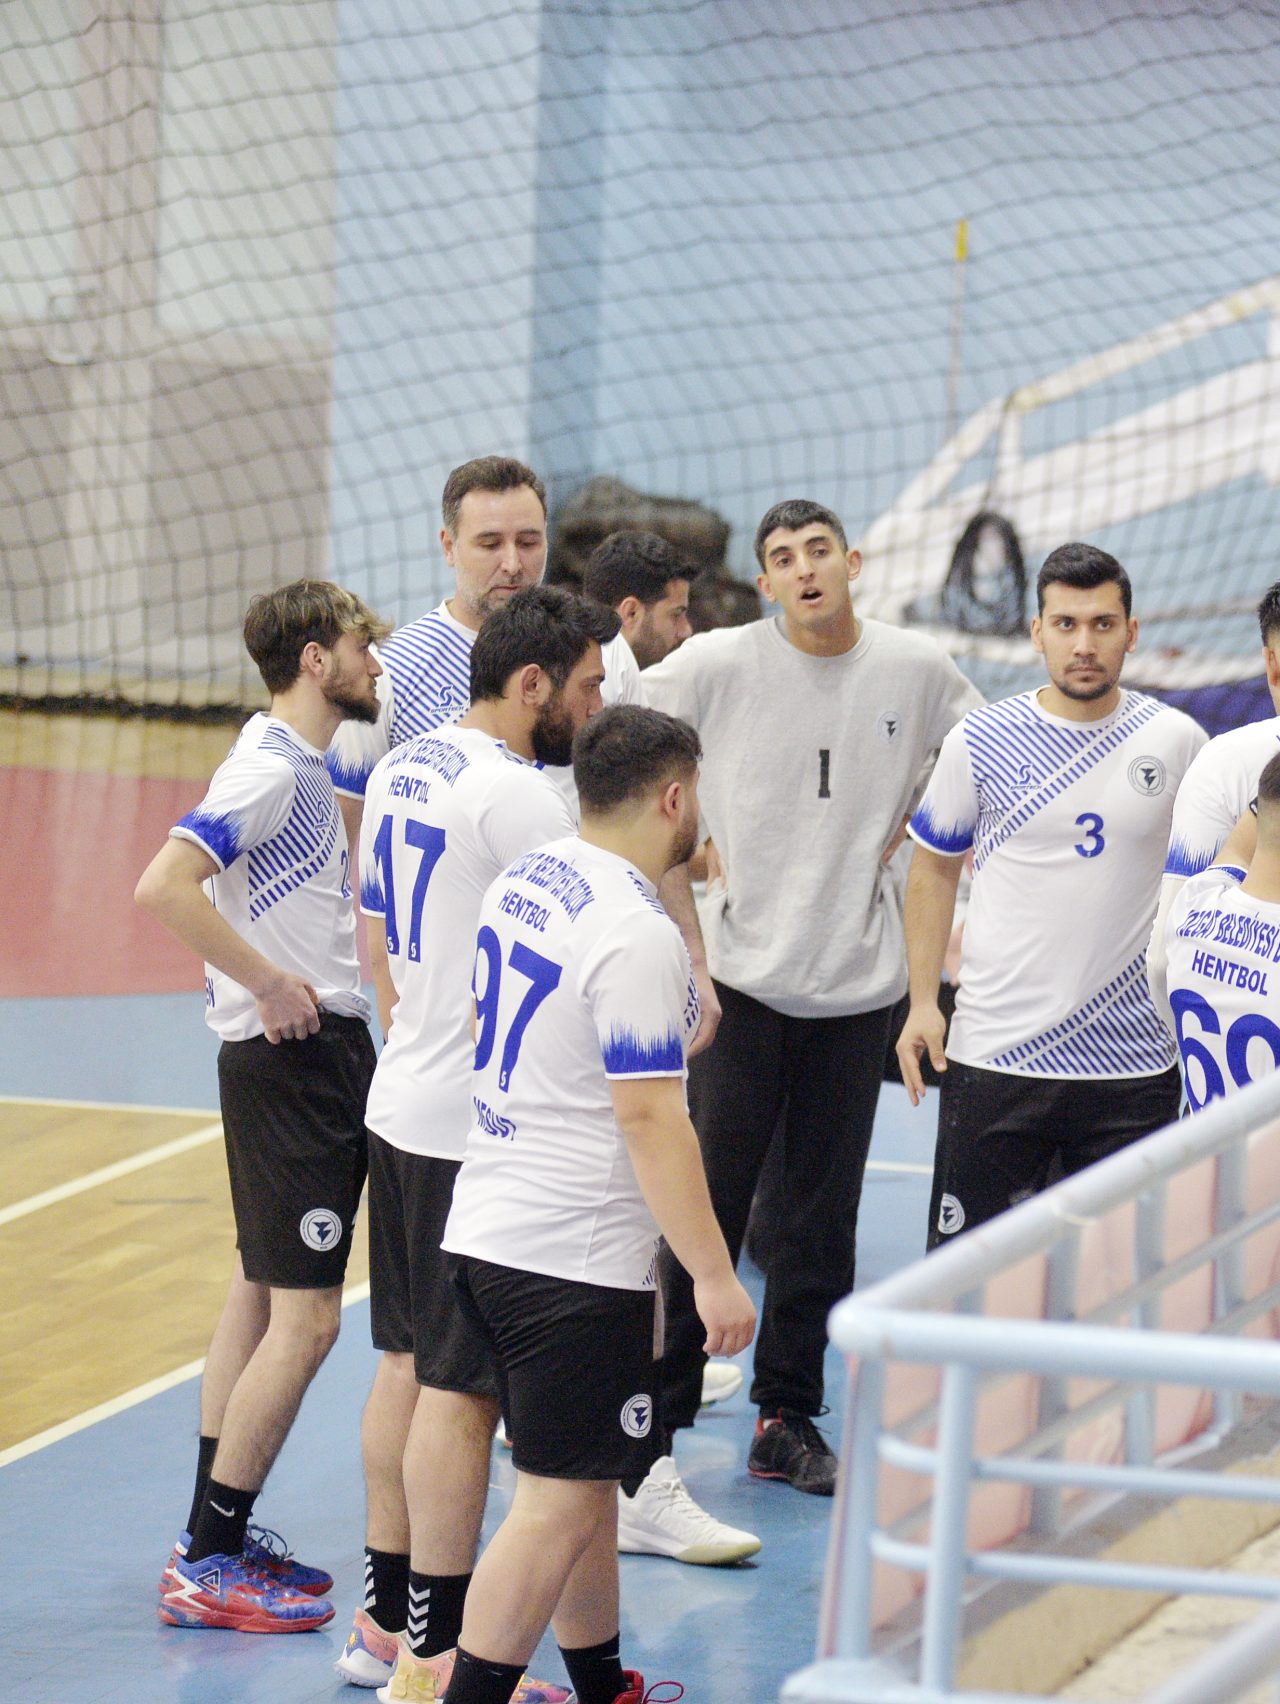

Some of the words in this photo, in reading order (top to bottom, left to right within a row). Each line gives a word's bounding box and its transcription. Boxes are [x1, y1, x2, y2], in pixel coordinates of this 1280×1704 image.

[1075, 813, 1105, 858] 3
[373, 814, 446, 963] 17
[498, 889, 551, 933] HENTBOL
[1192, 949, 1268, 996] HENTBOL
[471, 925, 563, 1093] 97
